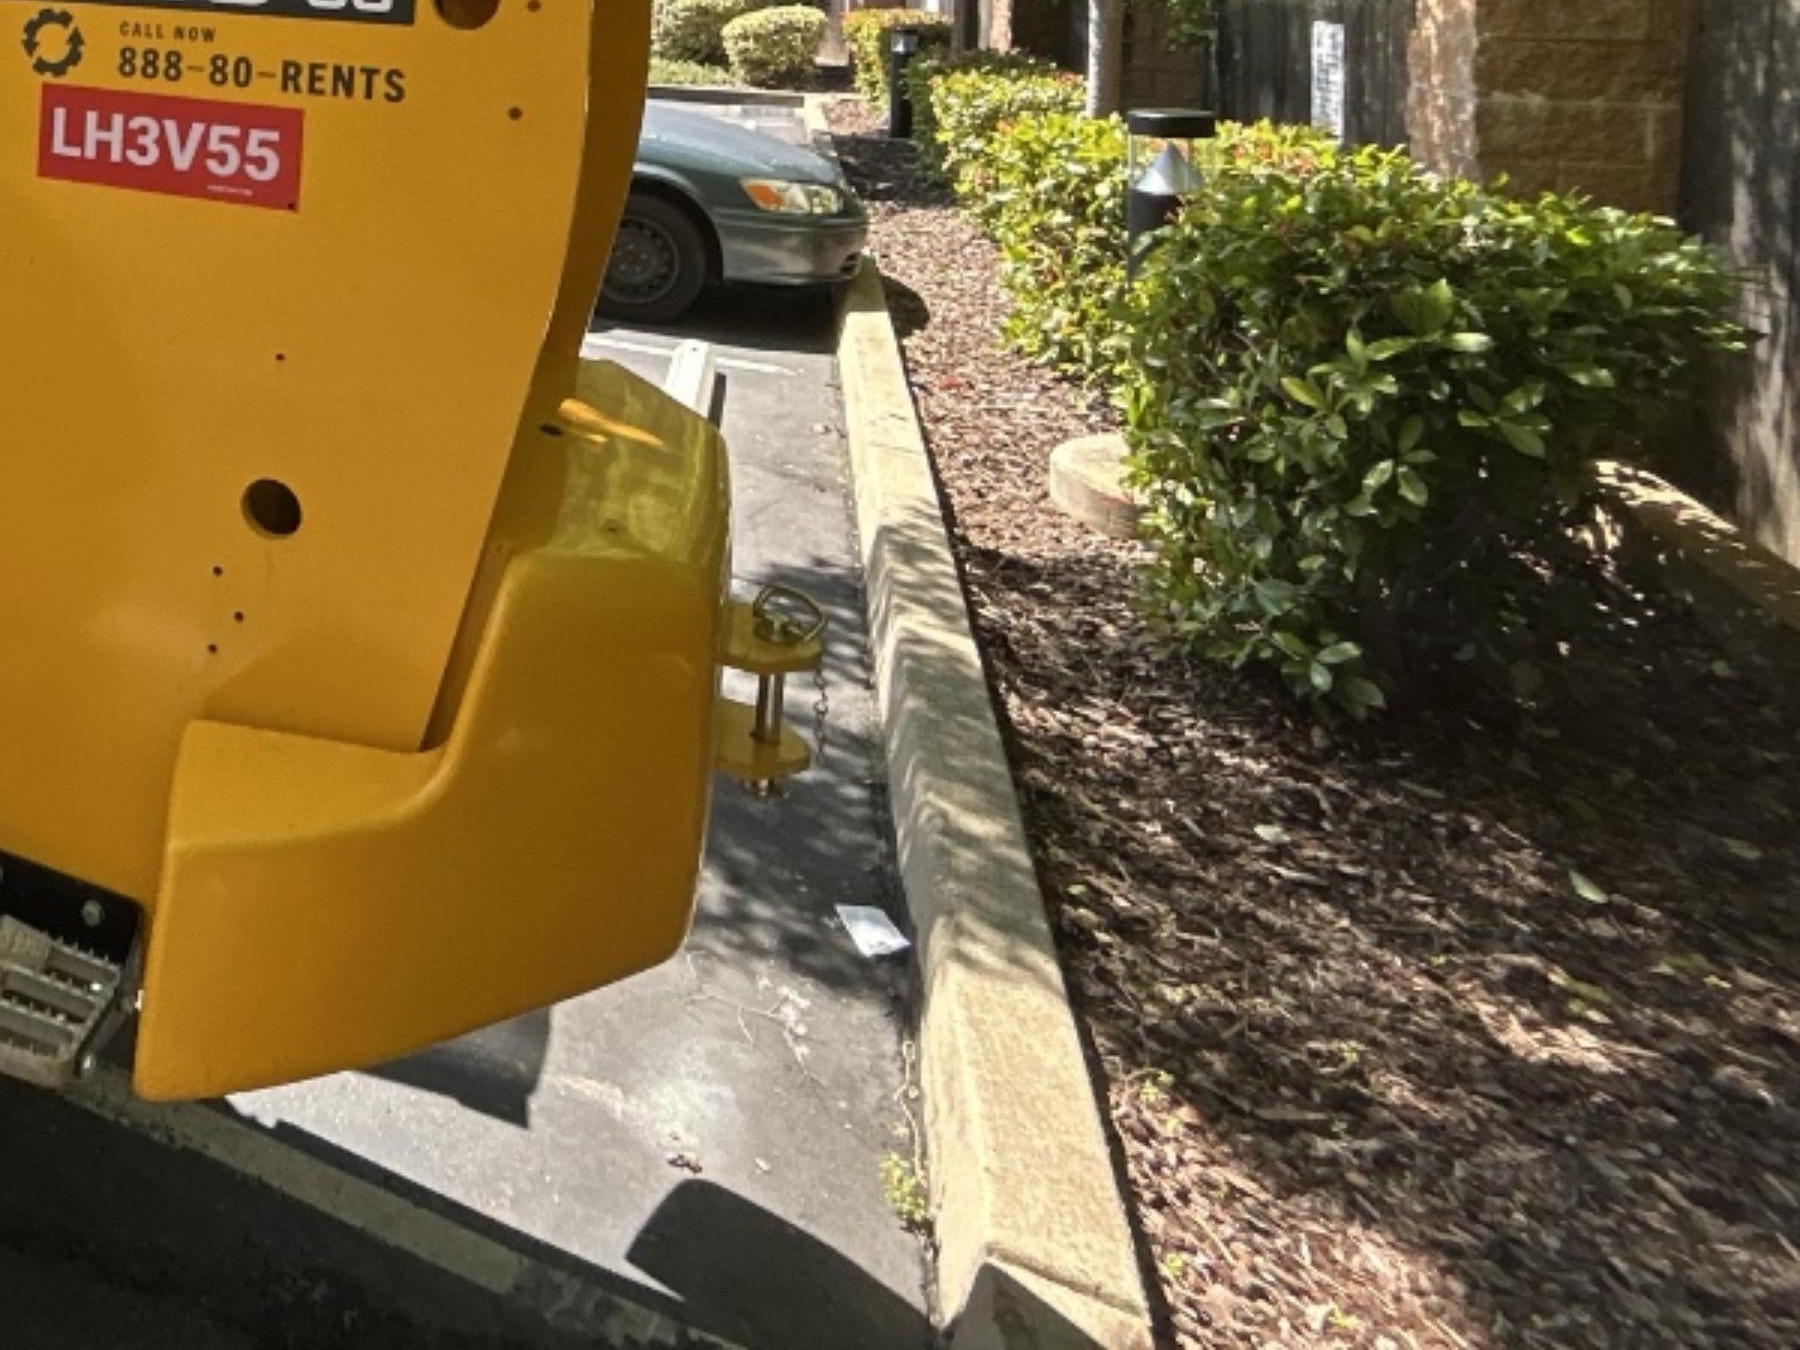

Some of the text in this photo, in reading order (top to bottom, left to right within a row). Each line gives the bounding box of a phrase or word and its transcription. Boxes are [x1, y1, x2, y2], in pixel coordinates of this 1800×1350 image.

[119, 21, 216, 43] CALL NOW
[119, 47, 406, 103] 888-80-RENTS
[52, 106, 281, 182] LH3V55
